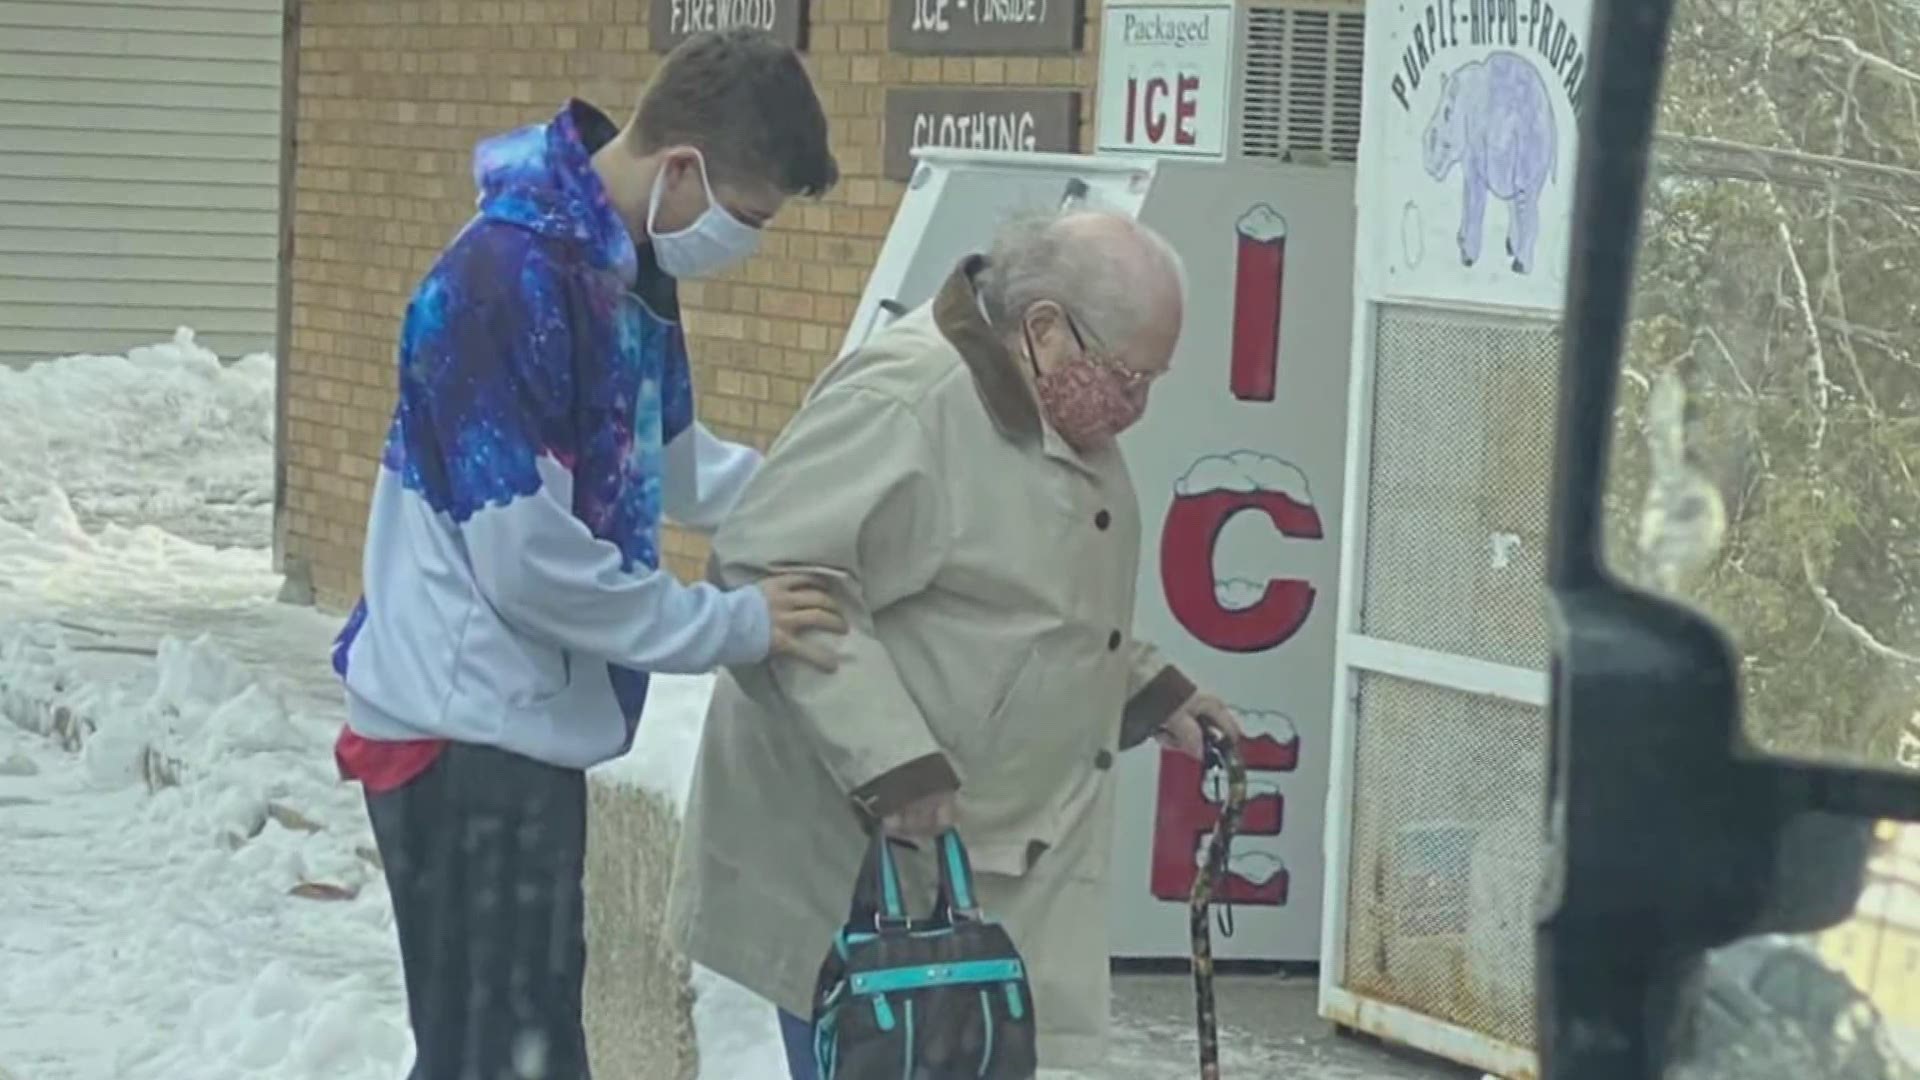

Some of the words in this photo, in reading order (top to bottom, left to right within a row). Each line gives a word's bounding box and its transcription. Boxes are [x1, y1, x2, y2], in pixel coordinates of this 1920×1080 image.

[670, 0, 776, 34] FIREWOOD
[912, 0, 949, 32] ICE
[1123, 13, 1209, 48] Packaged
[1124, 71, 1199, 145] ICE
[912, 111, 1036, 152] CLOTHING
[1150, 203, 1324, 906] ICE
